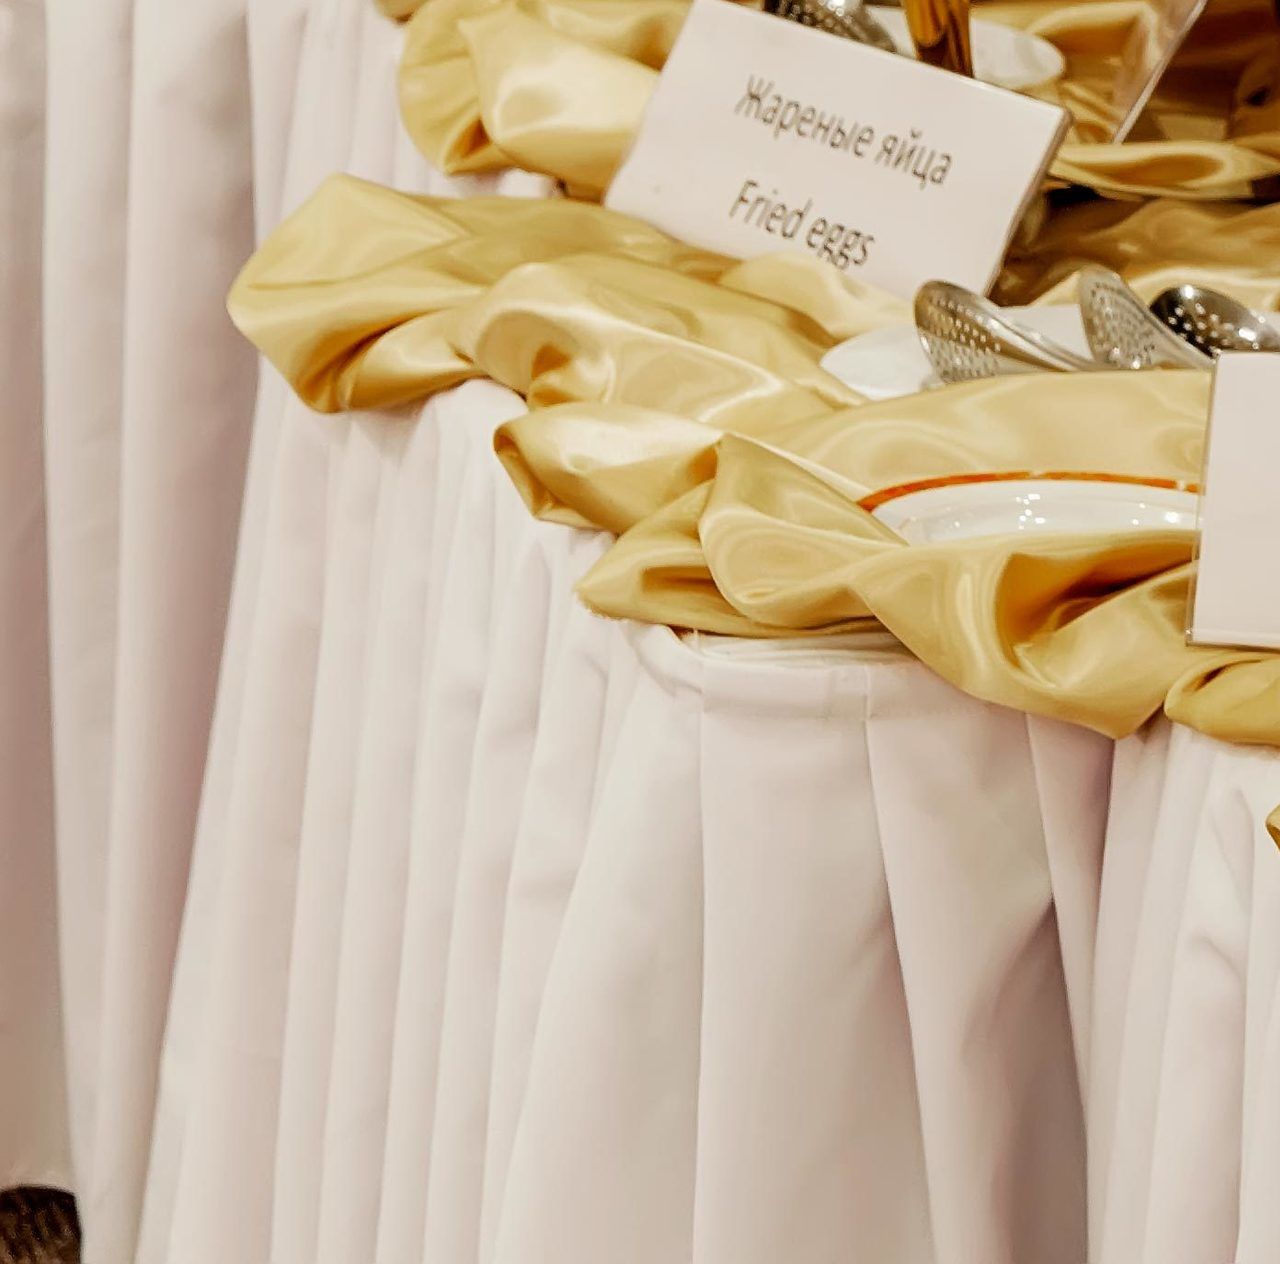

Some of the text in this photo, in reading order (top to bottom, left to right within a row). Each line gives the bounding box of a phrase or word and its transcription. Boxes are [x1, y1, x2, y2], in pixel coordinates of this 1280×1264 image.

[734, 74, 953, 190] Жареные яйца
[728, 178, 876, 272] Fried eggs
